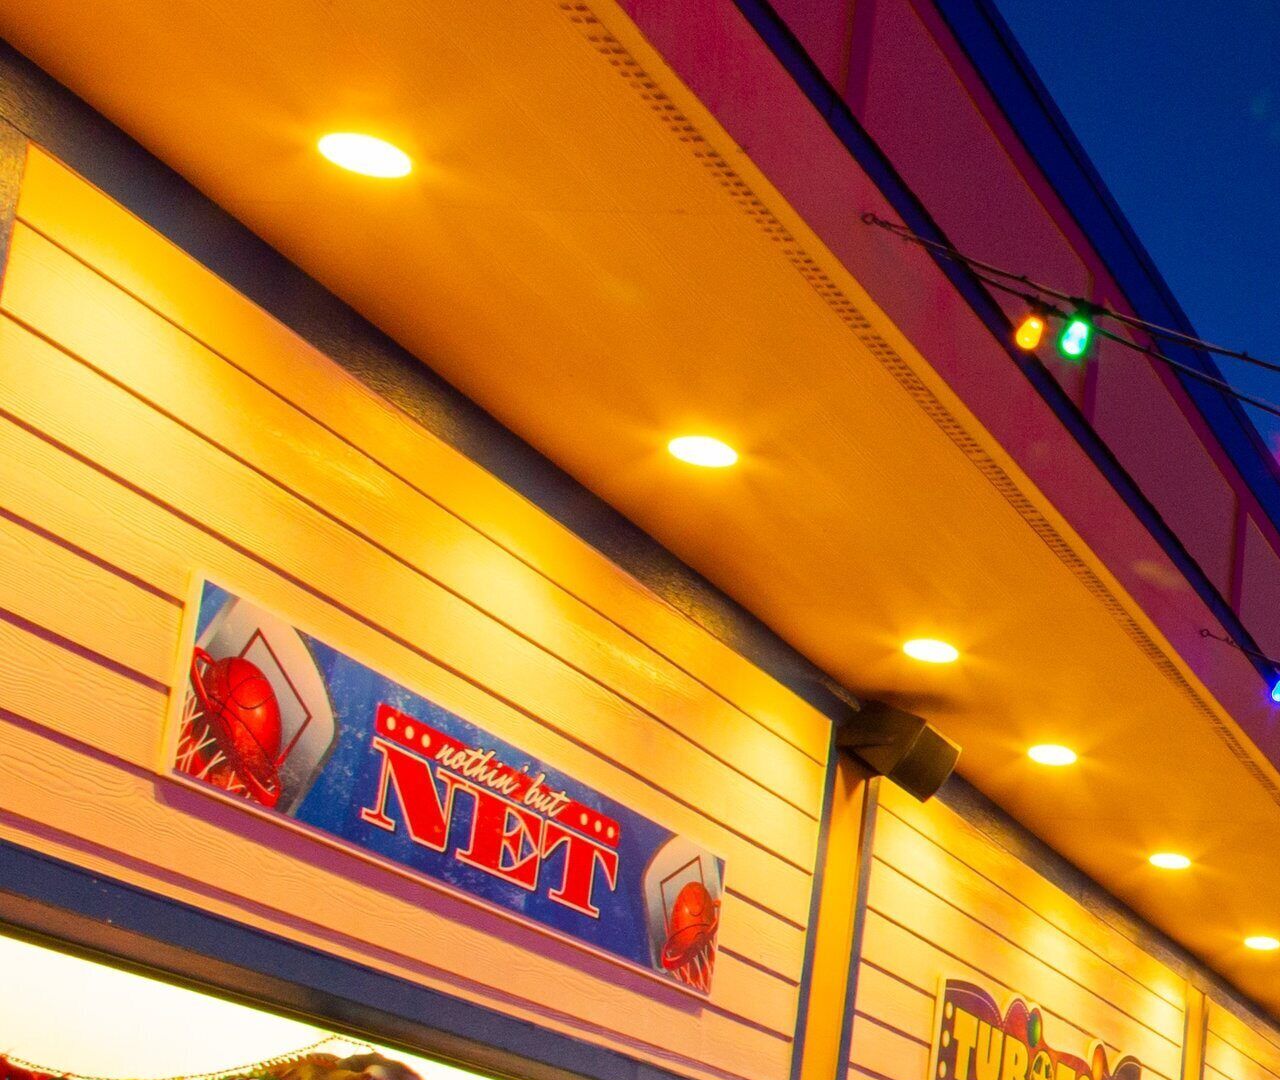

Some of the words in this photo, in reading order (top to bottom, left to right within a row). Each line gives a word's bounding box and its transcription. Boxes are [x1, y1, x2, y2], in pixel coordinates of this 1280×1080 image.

[360, 735, 619, 919] NET
[436, 743, 529, 796] nothin'
[524, 771, 571, 817] but
